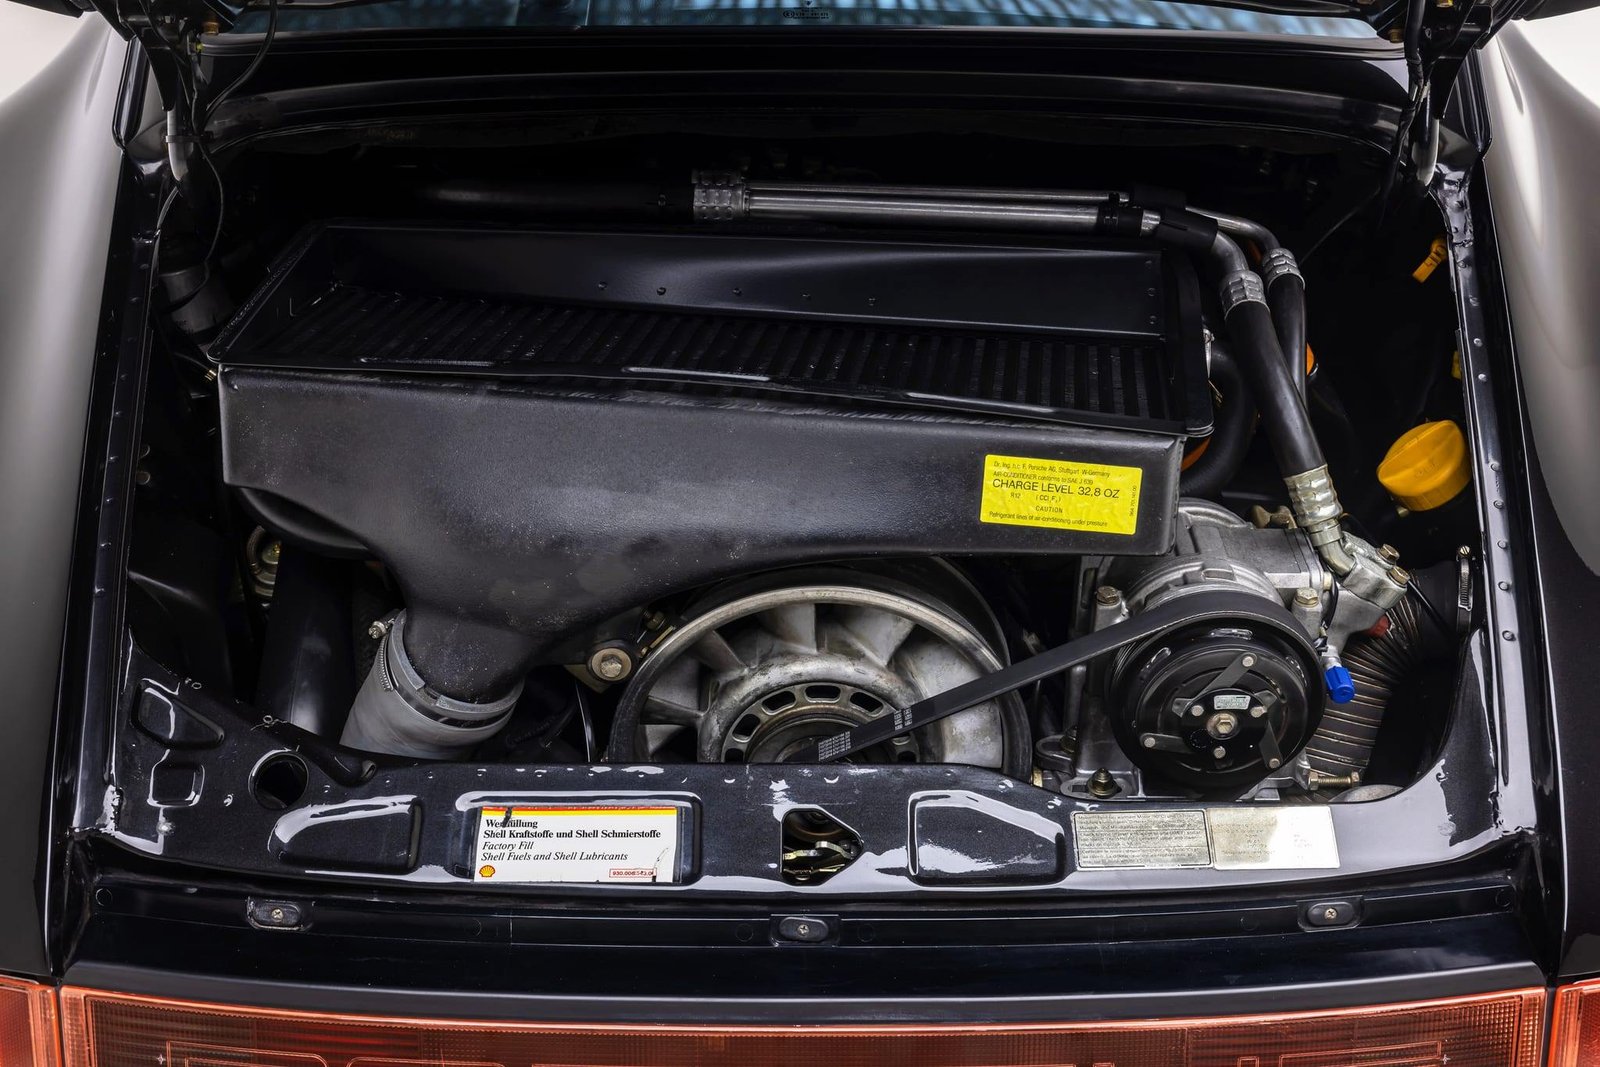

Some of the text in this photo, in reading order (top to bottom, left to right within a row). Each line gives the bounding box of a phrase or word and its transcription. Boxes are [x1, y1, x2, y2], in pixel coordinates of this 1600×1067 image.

[993, 471, 1038, 480] AIR-CONDITIONER
[1058, 467, 1080, 475] Stuttgart
[993, 479, 1120, 499] CHARGE LEVEL 32,8 OZ
[989, 511, 1015, 519] Refrigerant
[483, 829, 661, 838] Shell Kraftstoffe und Shell Schmierstoffe
[482, 841, 535, 851] Factory Fill
[481, 851, 628, 861] Shell Fuels and Shell Lubricants
